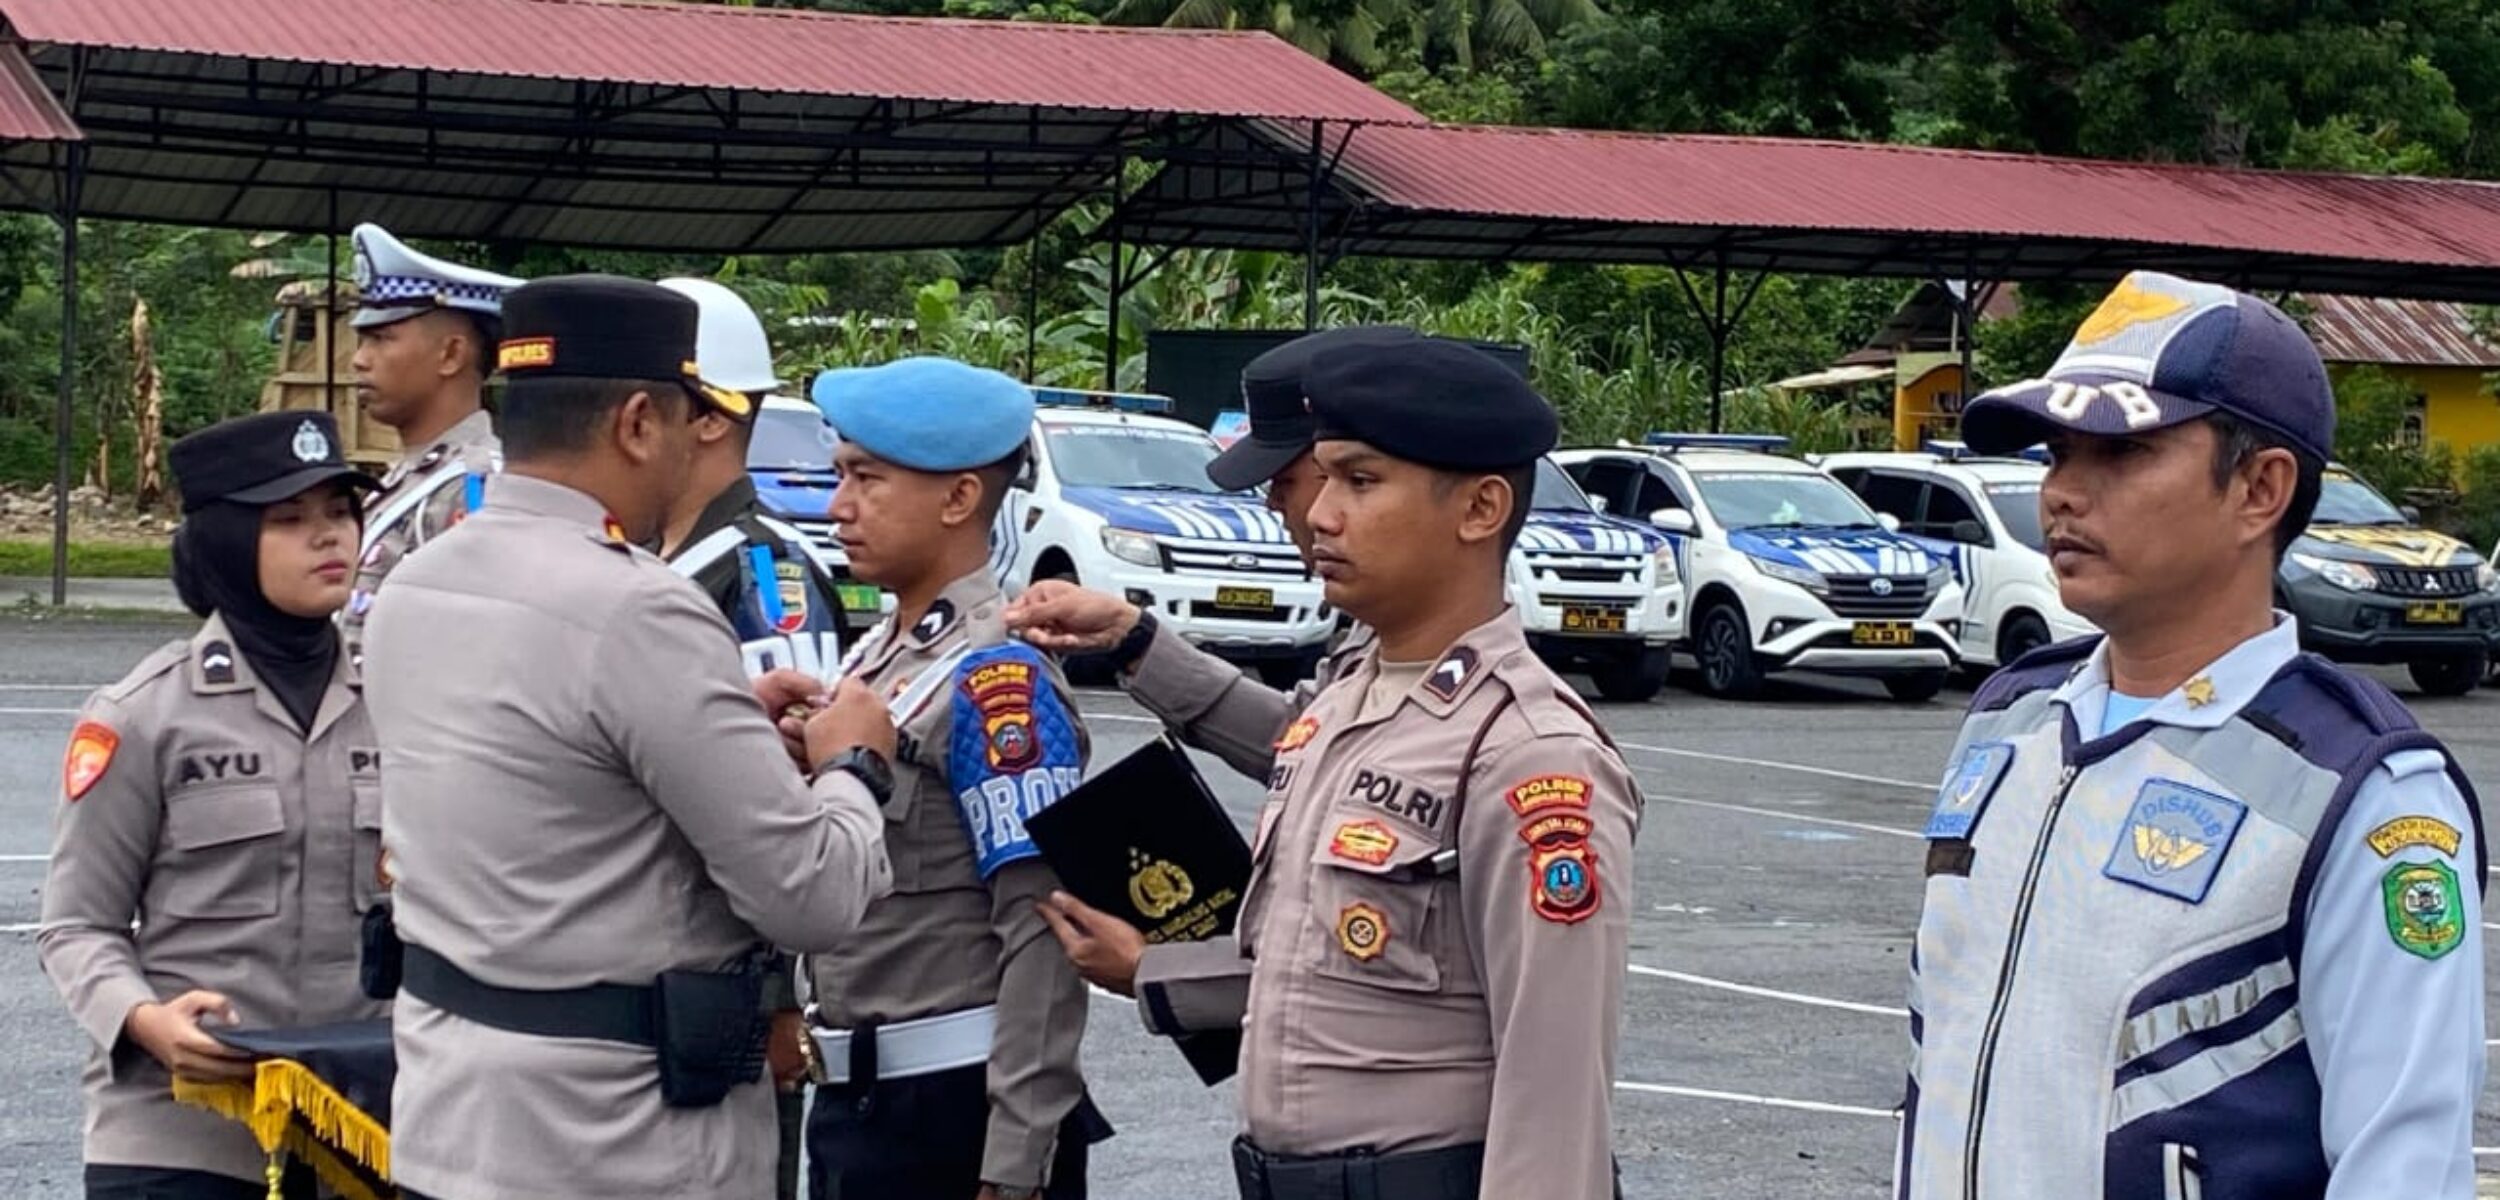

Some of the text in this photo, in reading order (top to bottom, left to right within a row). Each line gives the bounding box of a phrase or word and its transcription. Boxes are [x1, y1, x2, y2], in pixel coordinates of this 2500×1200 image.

[179, 752, 260, 784] AYU
[1349, 769, 1443, 828] POLRI
[2142, 796, 2222, 838] DISHUB
